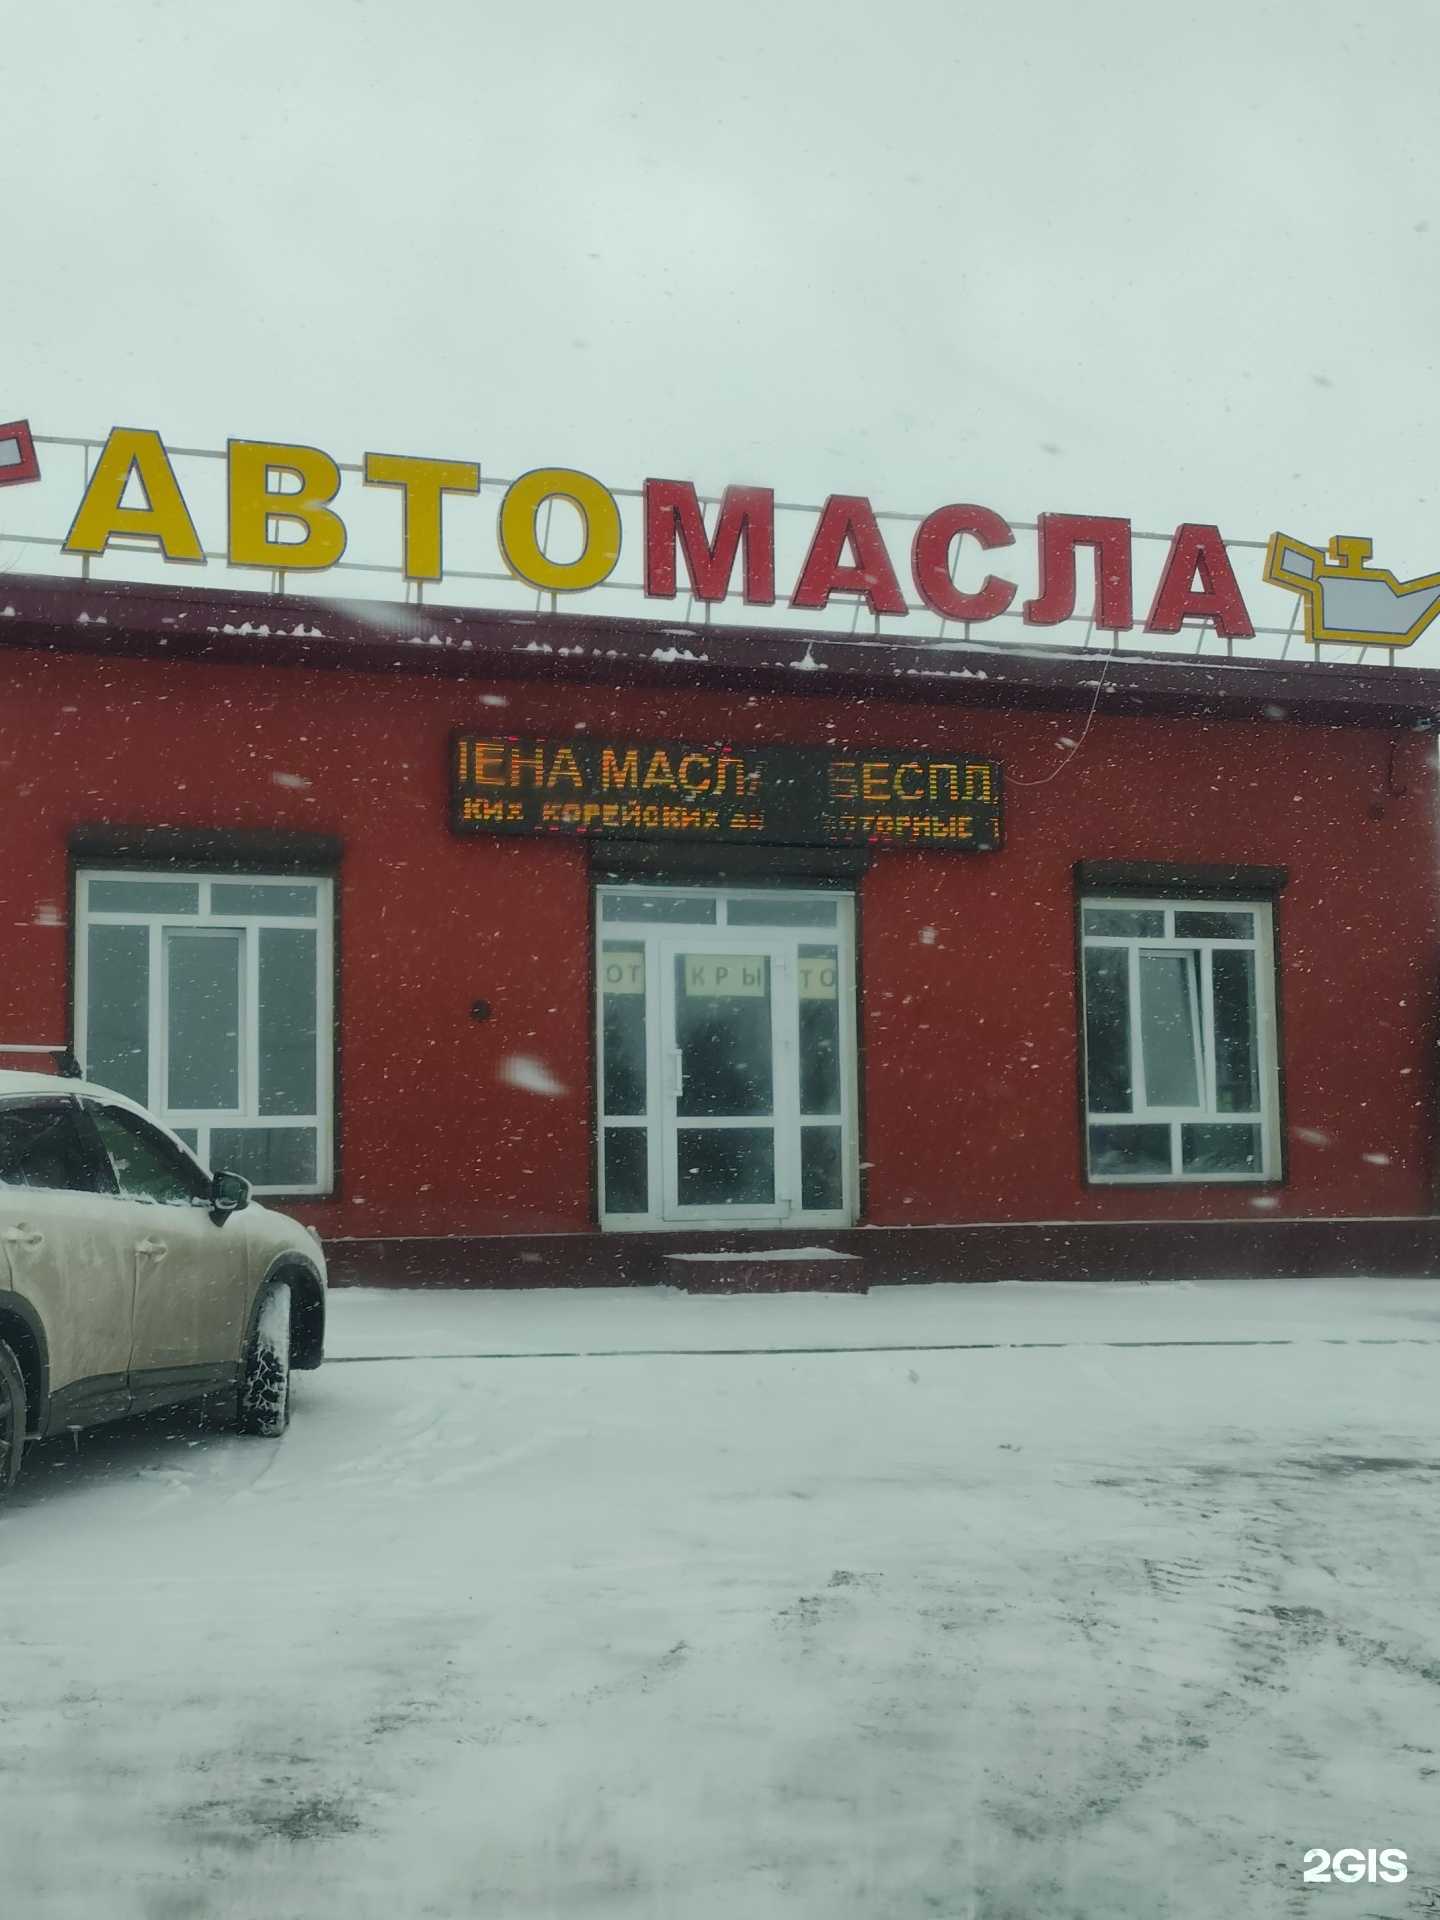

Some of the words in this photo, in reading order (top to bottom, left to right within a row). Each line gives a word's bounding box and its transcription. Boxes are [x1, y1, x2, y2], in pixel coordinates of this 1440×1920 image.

[457, 741, 583, 787] ЕНА
[606, 963, 641, 984] ОТ
[691, 966, 761, 987] КРЫ
[801, 968, 836, 988] ТО
